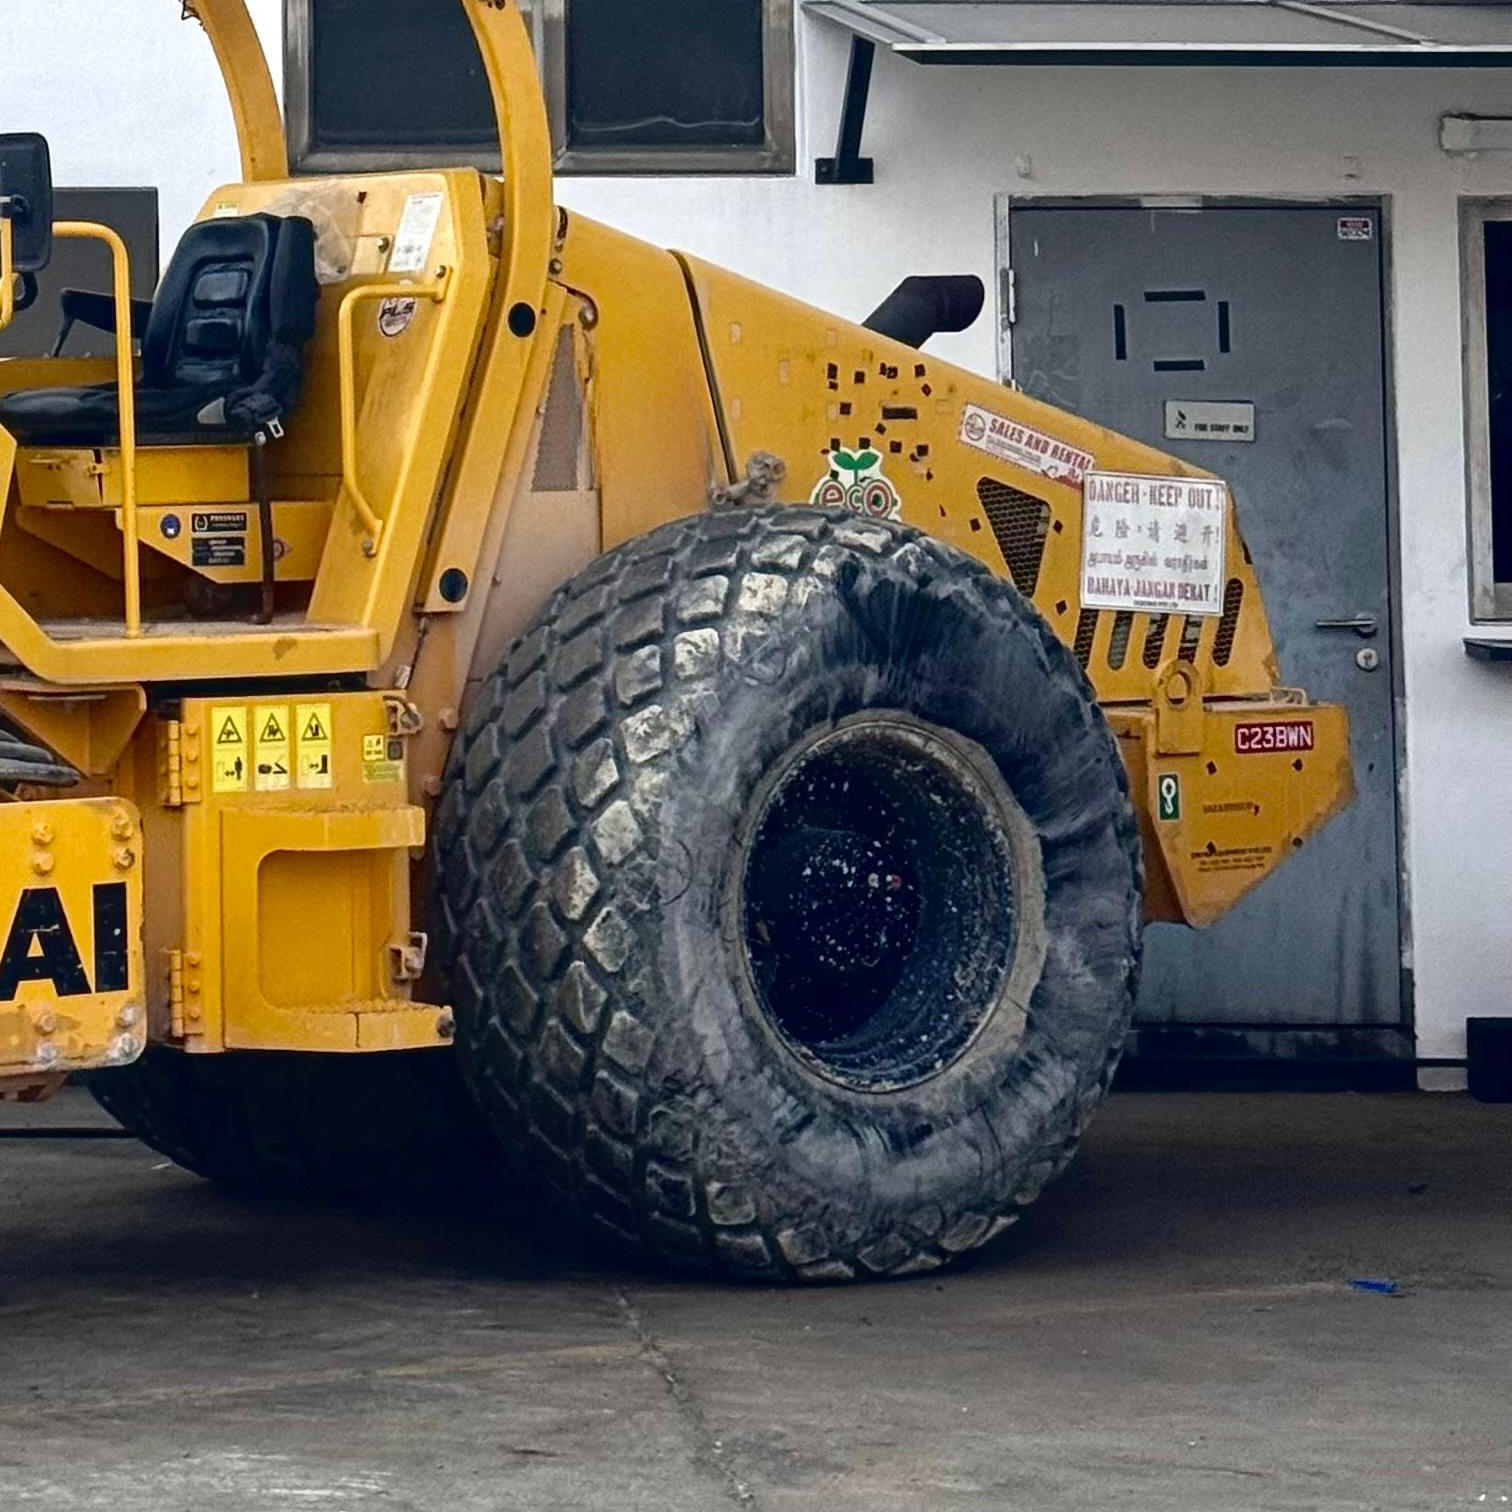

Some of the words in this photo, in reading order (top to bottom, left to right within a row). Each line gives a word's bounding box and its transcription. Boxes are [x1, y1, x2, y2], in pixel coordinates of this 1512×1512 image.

[989, 418, 1024, 444] SALES
[1024, 433, 1050, 454] AND
[1089, 479, 1140, 504] DANGER
[1149, 484, 1182, 506] KEEP
[1237, 725, 1312, 750] C23BWN
